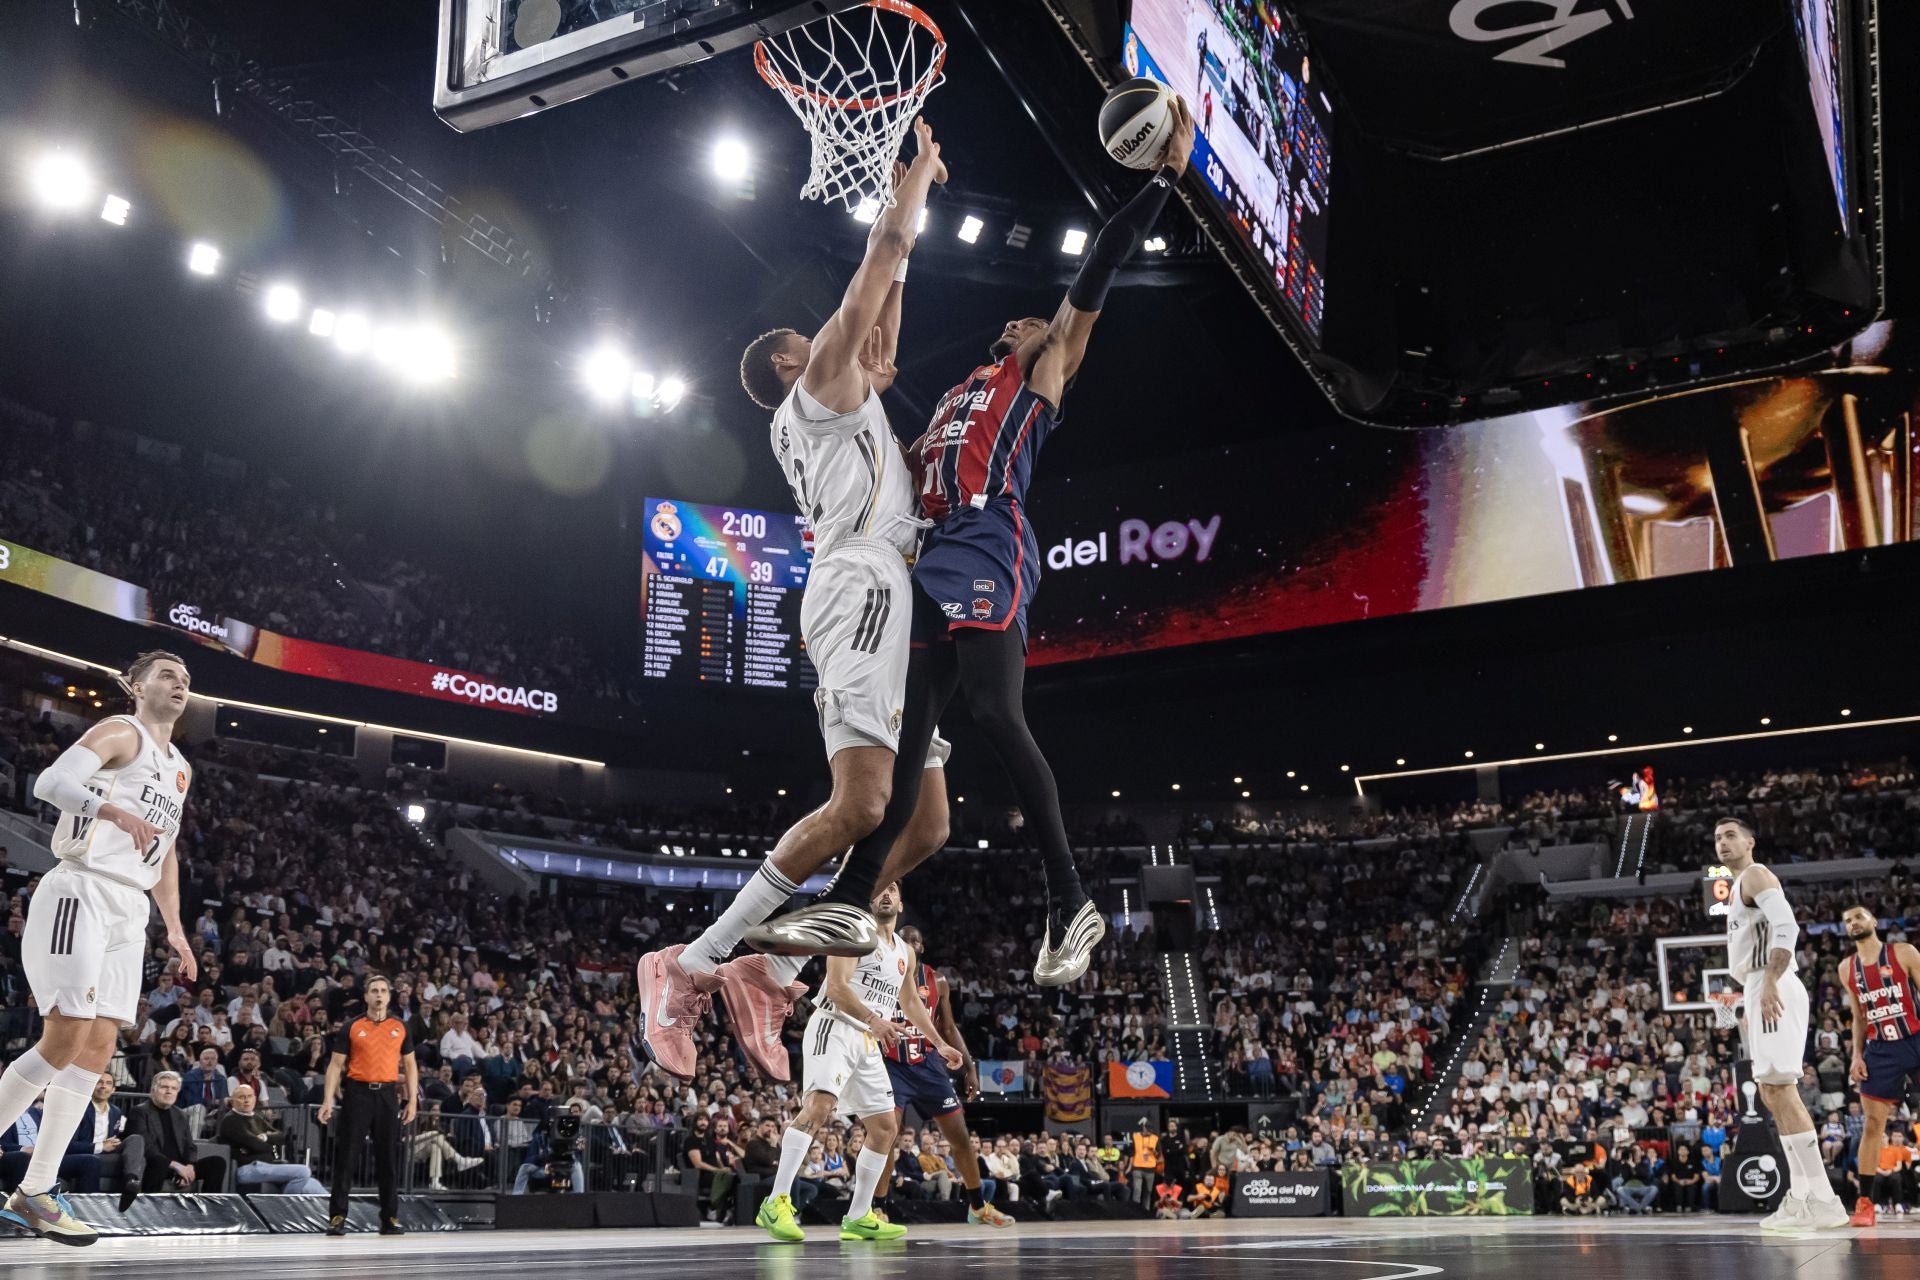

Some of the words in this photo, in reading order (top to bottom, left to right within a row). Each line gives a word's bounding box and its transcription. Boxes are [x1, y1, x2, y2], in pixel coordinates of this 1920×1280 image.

[1112, 121, 1155, 160] Wilson
[722, 511, 766, 539] 2:00
[1047, 532, 1107, 570] del
[706, 556, 728, 577] 47
[750, 561, 772, 582] 39
[169, 608, 211, 633] Copa
[211, 625, 228, 638] del
[431, 671, 558, 712] #CopaACB
[1712, 880, 1729, 900] 6
[1884, 1024, 1899, 1040] 9
[908, 1043, 921, 1060] 5
[1242, 1184, 1278, 1197] Copa
[1279, 1186, 1294, 1194] del
[1295, 1184, 1319, 1197] Rey
